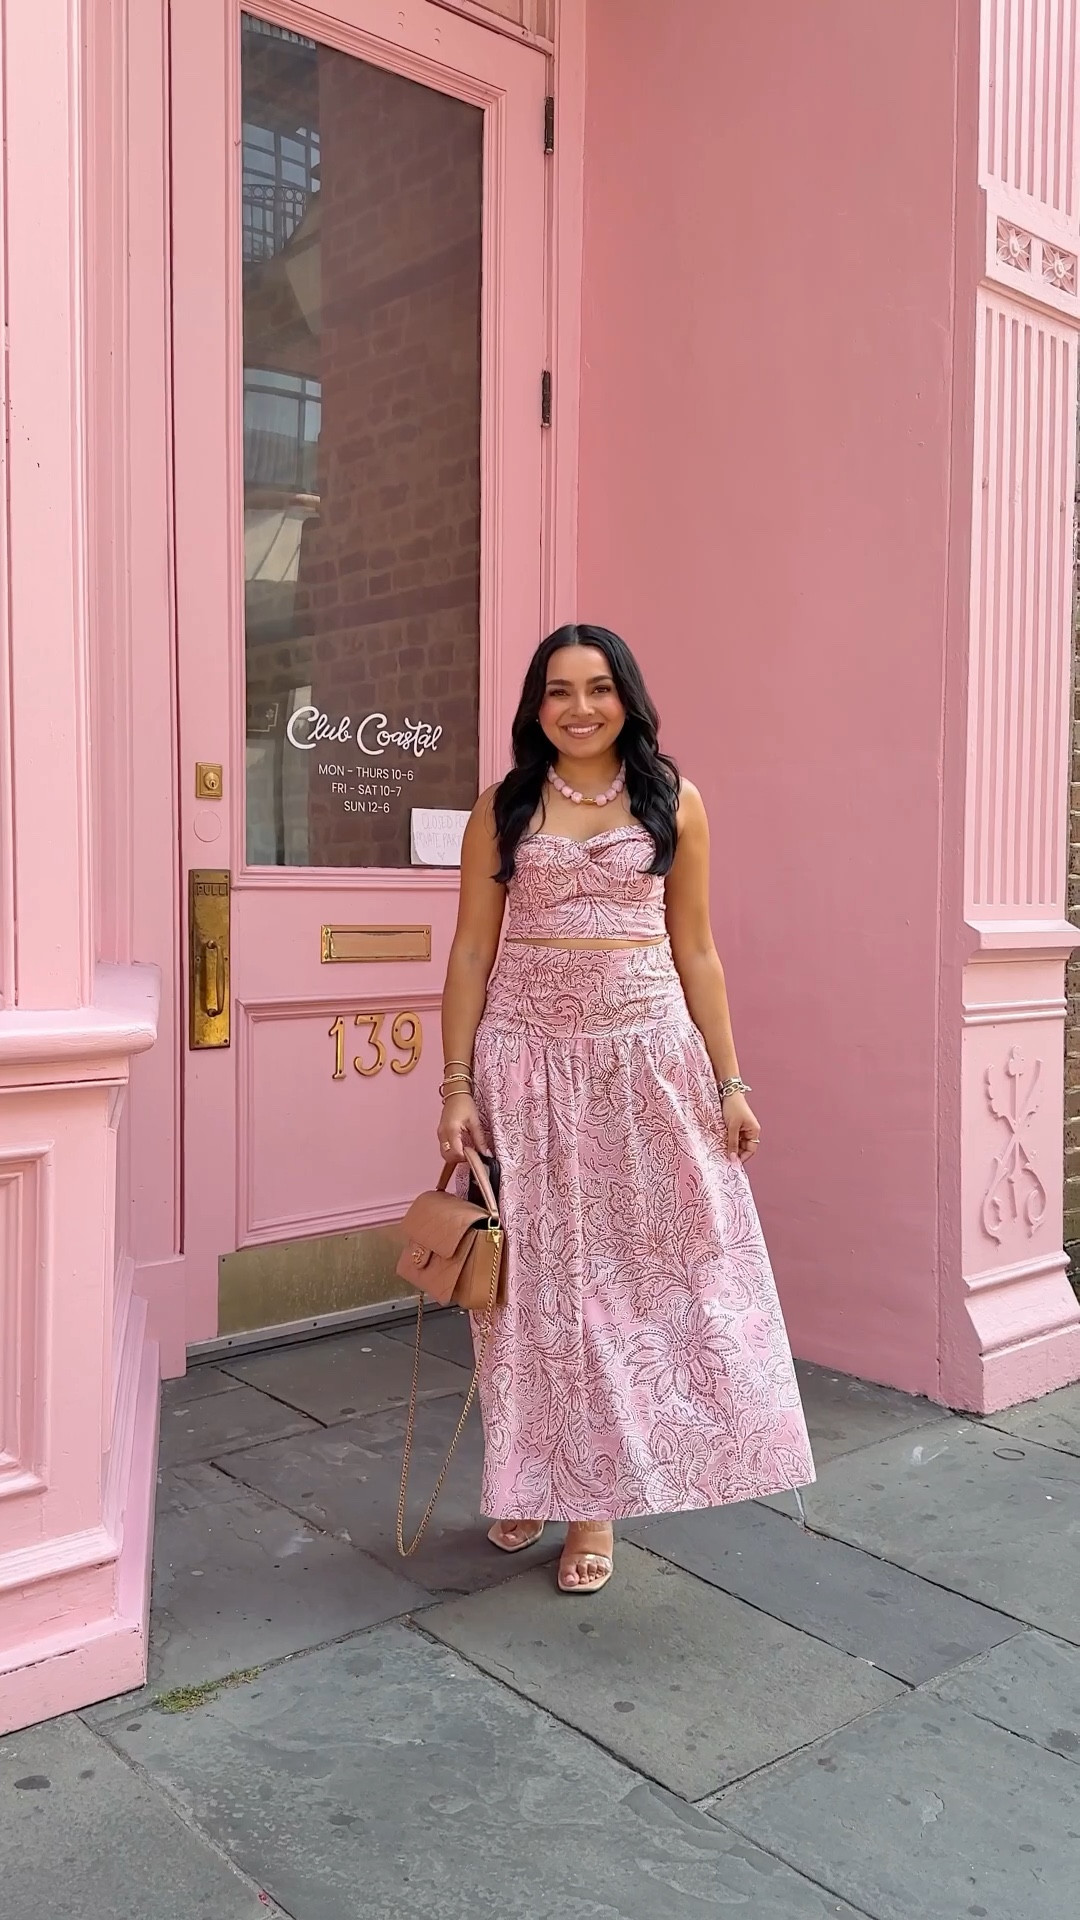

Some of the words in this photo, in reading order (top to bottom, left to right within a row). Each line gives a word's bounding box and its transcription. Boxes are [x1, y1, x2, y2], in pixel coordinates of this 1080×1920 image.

[286, 705, 352, 750] Club
[356, 712, 443, 758] Coastal
[318, 764, 345, 776] MON
[356, 766, 389, 780] THURS
[391, 768, 414, 781] 10-6
[331, 782, 347, 794] FRI
[358, 784, 377, 796] SAT
[379, 785, 402, 797] 10-7
[343, 800, 365, 812] SUN
[367, 801, 390, 814] 12-6
[328, 1010, 423, 1080] 139
